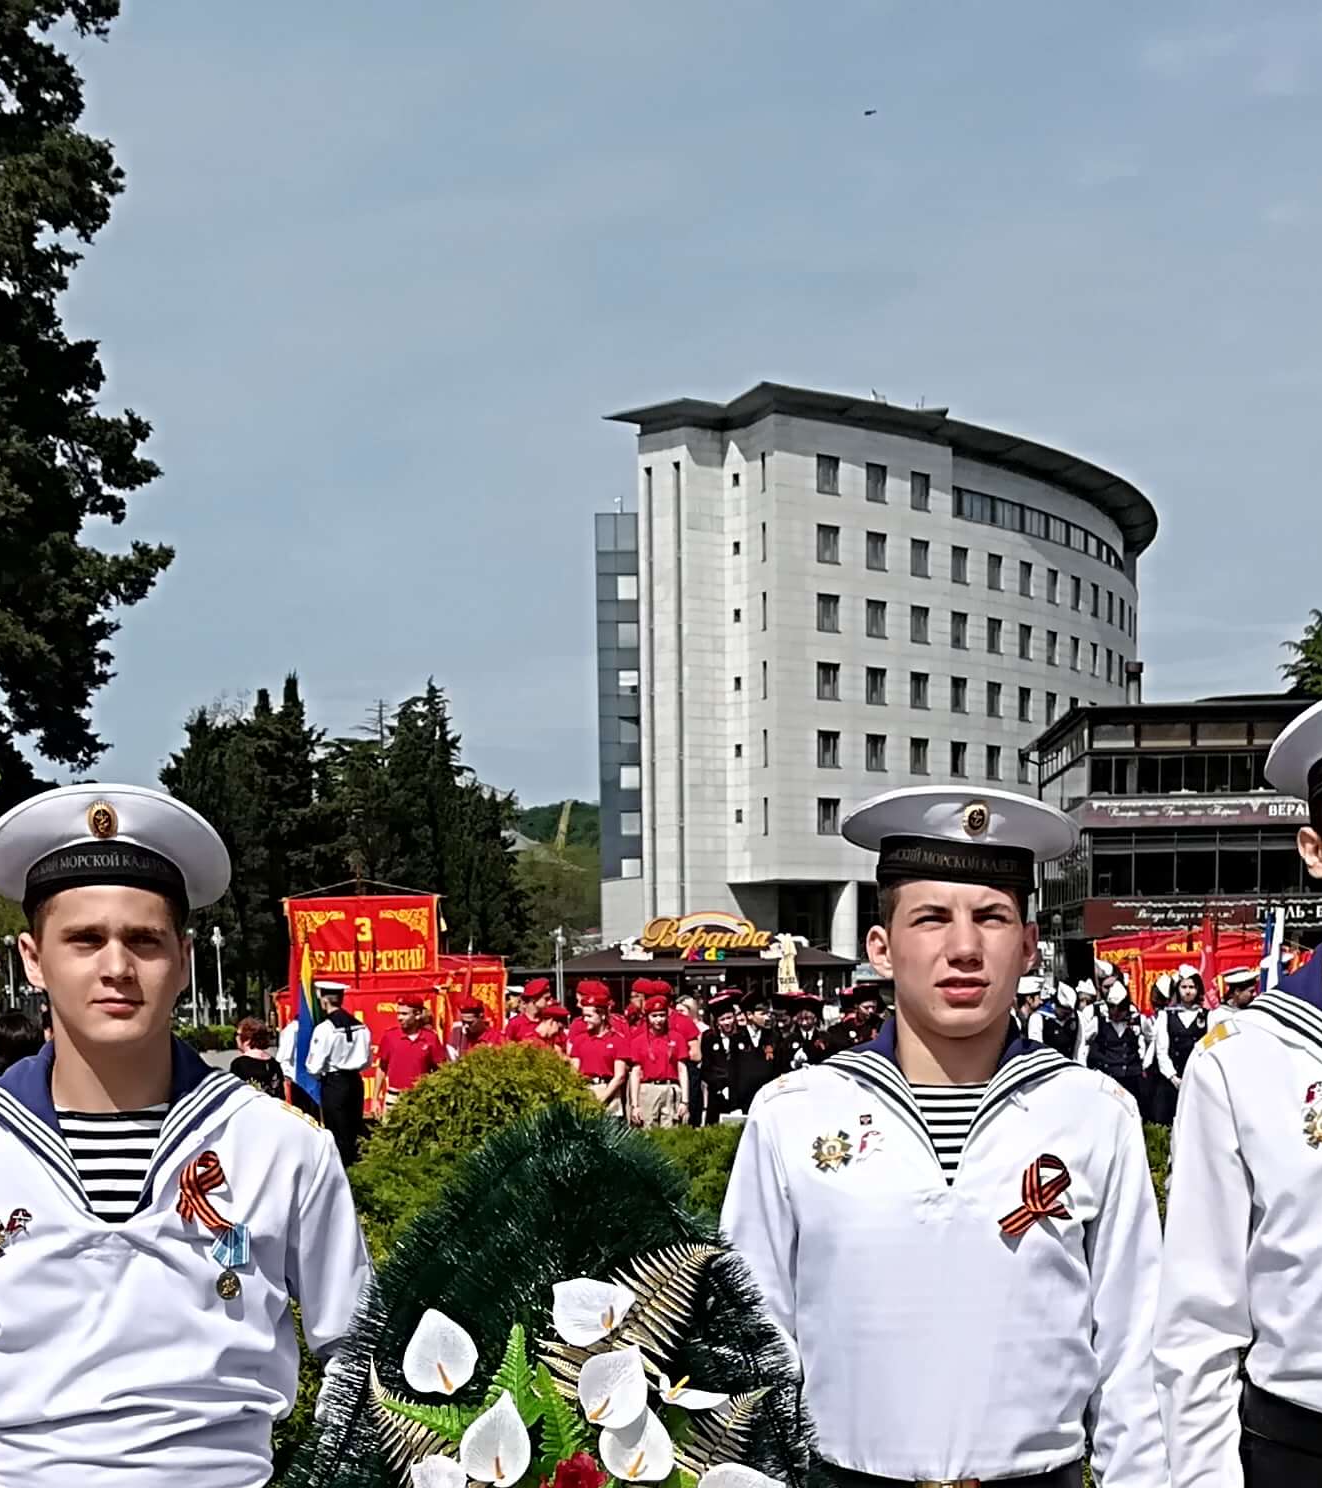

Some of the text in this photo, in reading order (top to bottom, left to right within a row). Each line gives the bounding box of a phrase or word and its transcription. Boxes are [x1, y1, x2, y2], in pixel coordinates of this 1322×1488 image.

[60, 852, 120, 869] МОРСКОЙ
[354, 917, 372, 941] 3
[641, 917, 772, 958] Веранда
